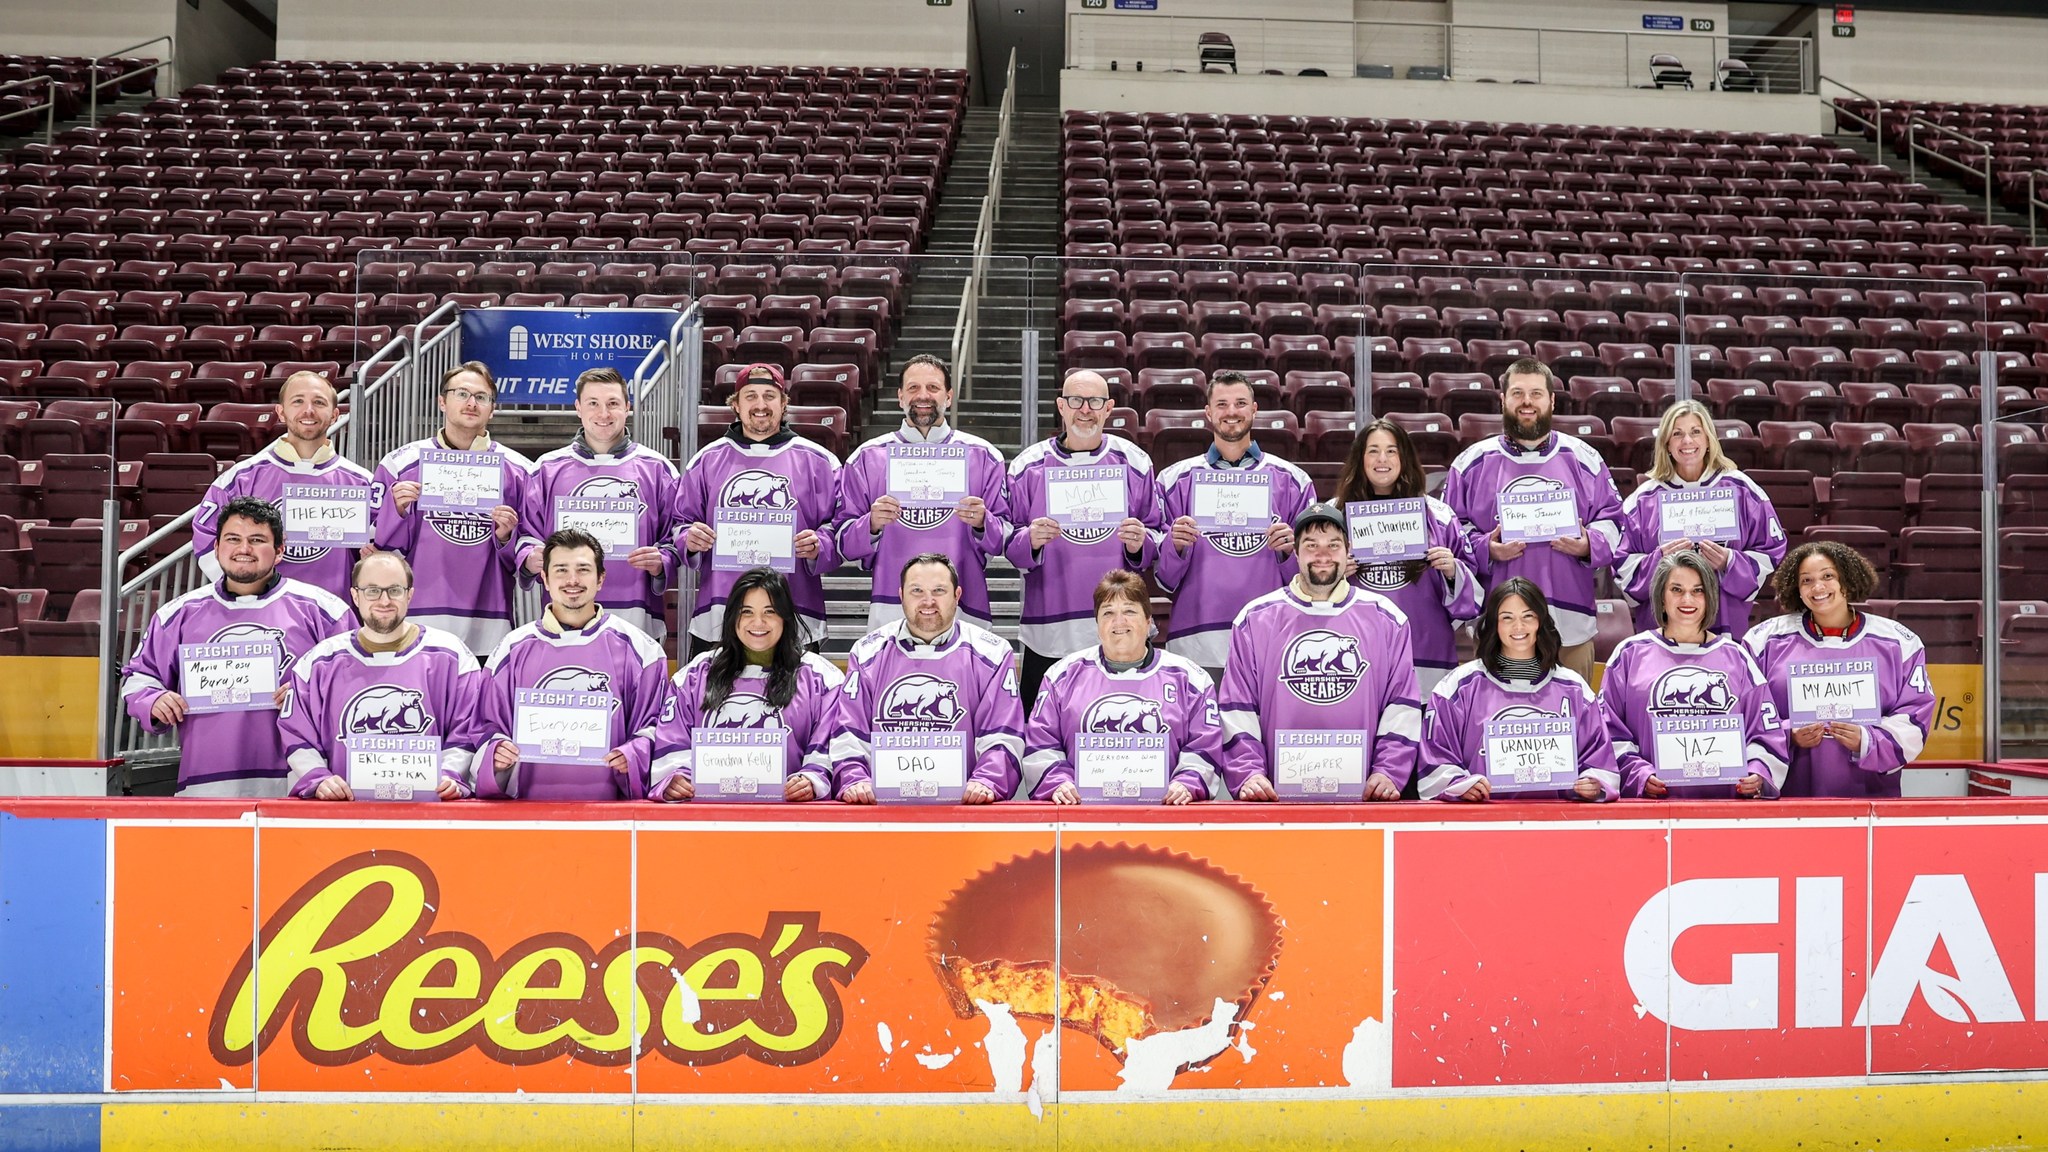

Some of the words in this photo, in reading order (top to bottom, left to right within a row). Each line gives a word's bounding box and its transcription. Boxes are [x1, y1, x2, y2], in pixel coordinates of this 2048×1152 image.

[1694, 20, 1711, 29] 120
[1837, 27, 1851, 36] 119
[533, 333, 586, 349] WEST
[589, 334, 654, 350] SHORE
[570, 352, 614, 361] HOME
[527, 378, 569, 394] THE
[423, 452, 430, 462] I
[433, 453, 473, 464] FIGHT
[475, 454, 501, 465] FOR
[889, 446, 896, 456] I
[900, 446, 938, 457] FIGHT
[941, 447, 965, 457] FOR
[1048, 470, 1054, 480] I
[1058, 469, 1096, 480] FIGHT
[1099, 468, 1123, 478] FOR
[1195, 472, 1202, 482] I
[1205, 472, 1242, 483] FIGHT
[1245, 474, 1269, 484] FOR
[286, 487, 292, 498] I
[296, 487, 337, 499] FIGHT
[340, 489, 366, 499] FOR
[370, 482, 386, 509] 3
[1065, 483, 1105, 504] MOM
[1217, 488, 1240, 499] Hunter
[1500, 495, 1506, 503] I
[1509, 493, 1545, 503] FIGHT
[1548, 491, 1571, 501] FOR
[1661, 493, 1667, 502] I
[1670, 491, 1707, 502] FIGHT
[1710, 489, 1734, 499] FOR
[288, 507, 318, 520] THE
[321, 506, 357, 520] KIDS
[558, 500, 565, 509] I
[568, 500, 607, 510] FIGHT
[610, 501, 635, 511] FOR
[1349, 506, 1355, 515] I
[1359, 503, 1395, 514] FIGHT
[1398, 501, 1422, 511] FOR
[717, 511, 723, 521] I
[727, 511, 765, 522] FIGHT
[768, 513, 793, 523] FOR
[902, 509, 943, 525] BEARS
[443, 524, 487, 539] BEARS
[1352, 525, 1374, 540] Aunt
[1377, 520, 1420, 534] Charlene
[1769, 517, 1785, 541] 4
[1221, 535, 1261, 551] BEARS
[1366, 571, 1406, 585] BEARS
[183, 647, 191, 659] I
[195, 646, 240, 658] FIGHT
[244, 643, 273, 655] FOR
[1789, 664, 1797, 675] I
[1801, 662, 1843, 675] FIGHT
[1846, 660, 1874, 673] FOR
[842, 670, 860, 699] 4
[1002, 668, 1018, 697] 4
[1802, 682, 1820, 700] MY
[1824, 680, 1865, 698] AUNT
[1163, 683, 1177, 703] C
[1300, 682, 1346, 699] BEARS
[518, 691, 526, 703] I
[530, 692, 576, 706] FIGHT
[579, 695, 608, 708] FOR
[660, 695, 678, 723] 3
[1205, 698, 1221, 727] 2
[1760, 701, 1781, 730] 2
[529, 712, 604, 735] Everyone
[1424, 708, 1437, 741] 7
[1487, 724, 1495, 736] I
[1499, 723, 1541, 736] FIGHT
[1544, 721, 1572, 733] FOR
[1655, 720, 1663, 732] I
[1667, 719, 1710, 731] FIGHT
[1712, 717, 1740, 729] FOR
[350, 737, 358, 749] I
[361, 738, 406, 750] FIGHT
[409, 739, 436, 751] FOR
[695, 732, 703, 743] I
[707, 732, 751, 744] FIGHT
[754, 732, 783, 744] FOR
[874, 736, 882, 747] I
[886, 735, 931, 748] FIGHT
[934, 735, 962, 747] FOR
[1079, 736, 1087, 748] I
[1090, 736, 1134, 748] FIGHT
[1137, 736, 1165, 748] FOR
[1278, 733, 1286, 744] I
[1290, 733, 1332, 745] FIGHT
[1335, 733, 1363, 745] FOR
[1501, 737, 1560, 754] GRANDPA
[1675, 736, 1724, 762] YAZ
[358, 753, 387, 765] ERIC
[401, 754, 432, 767] BISH
[702, 753, 744, 768] Grandma
[747, 752, 773, 773] Kelly
[897, 755, 935, 773] DAD
[1516, 752, 1546, 767] JOE
[381, 770, 395, 779] JJ
[406, 770, 427, 780] KM
[1286, 757, 1344, 779] SHEARER
[222, 863, 855, 1053] Reese's
[1623, 872, 2048, 1031] GIA
